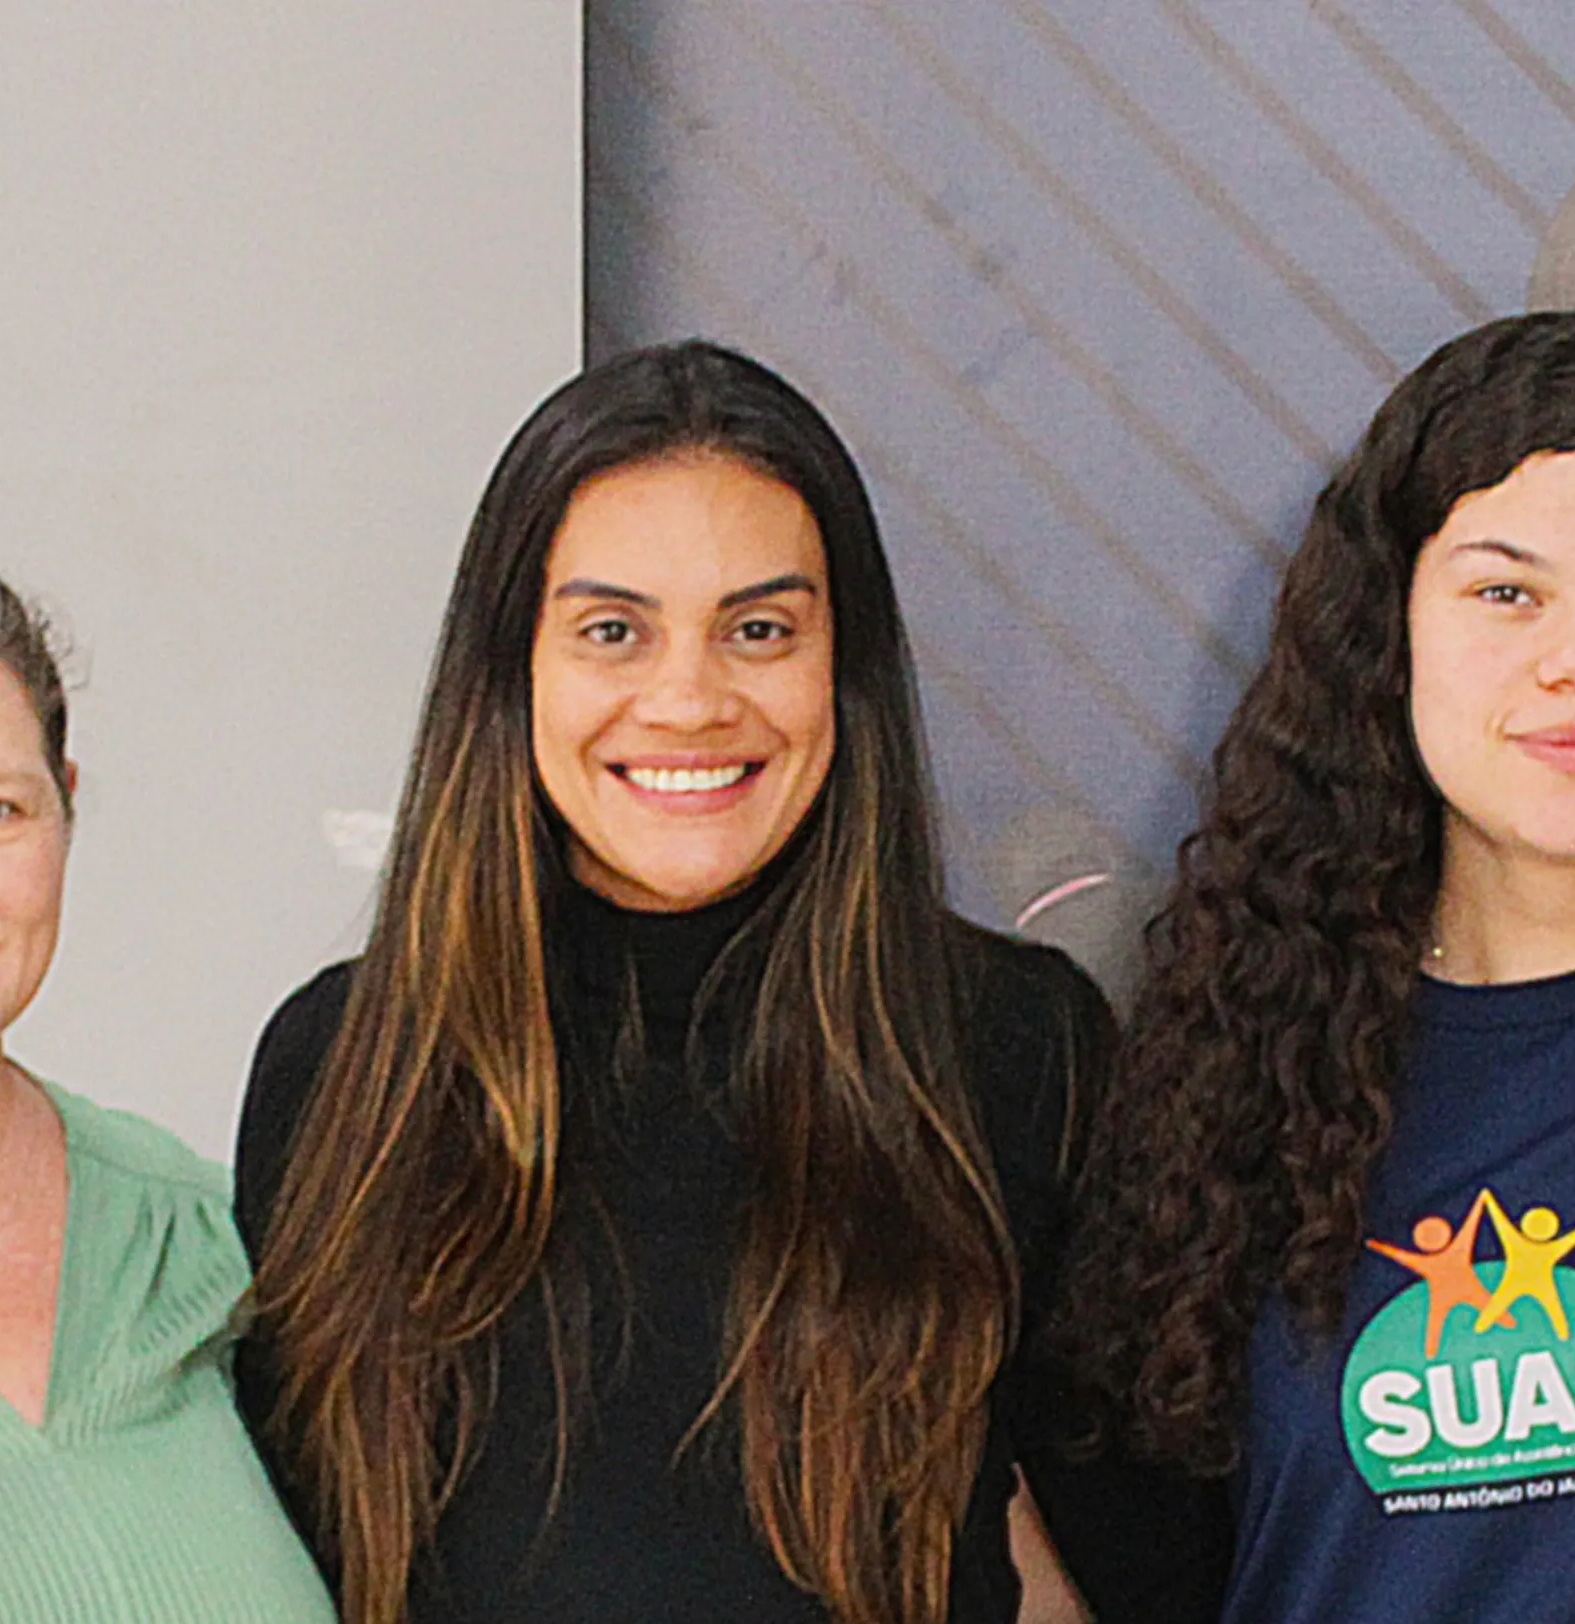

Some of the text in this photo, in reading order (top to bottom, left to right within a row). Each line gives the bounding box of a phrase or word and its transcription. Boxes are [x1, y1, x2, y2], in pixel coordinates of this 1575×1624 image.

[1383, 1493, 1441, 1514] SANTO
[1443, 1484, 1524, 1509] ANTÔNIO
[1526, 1479, 1555, 1499] DO
